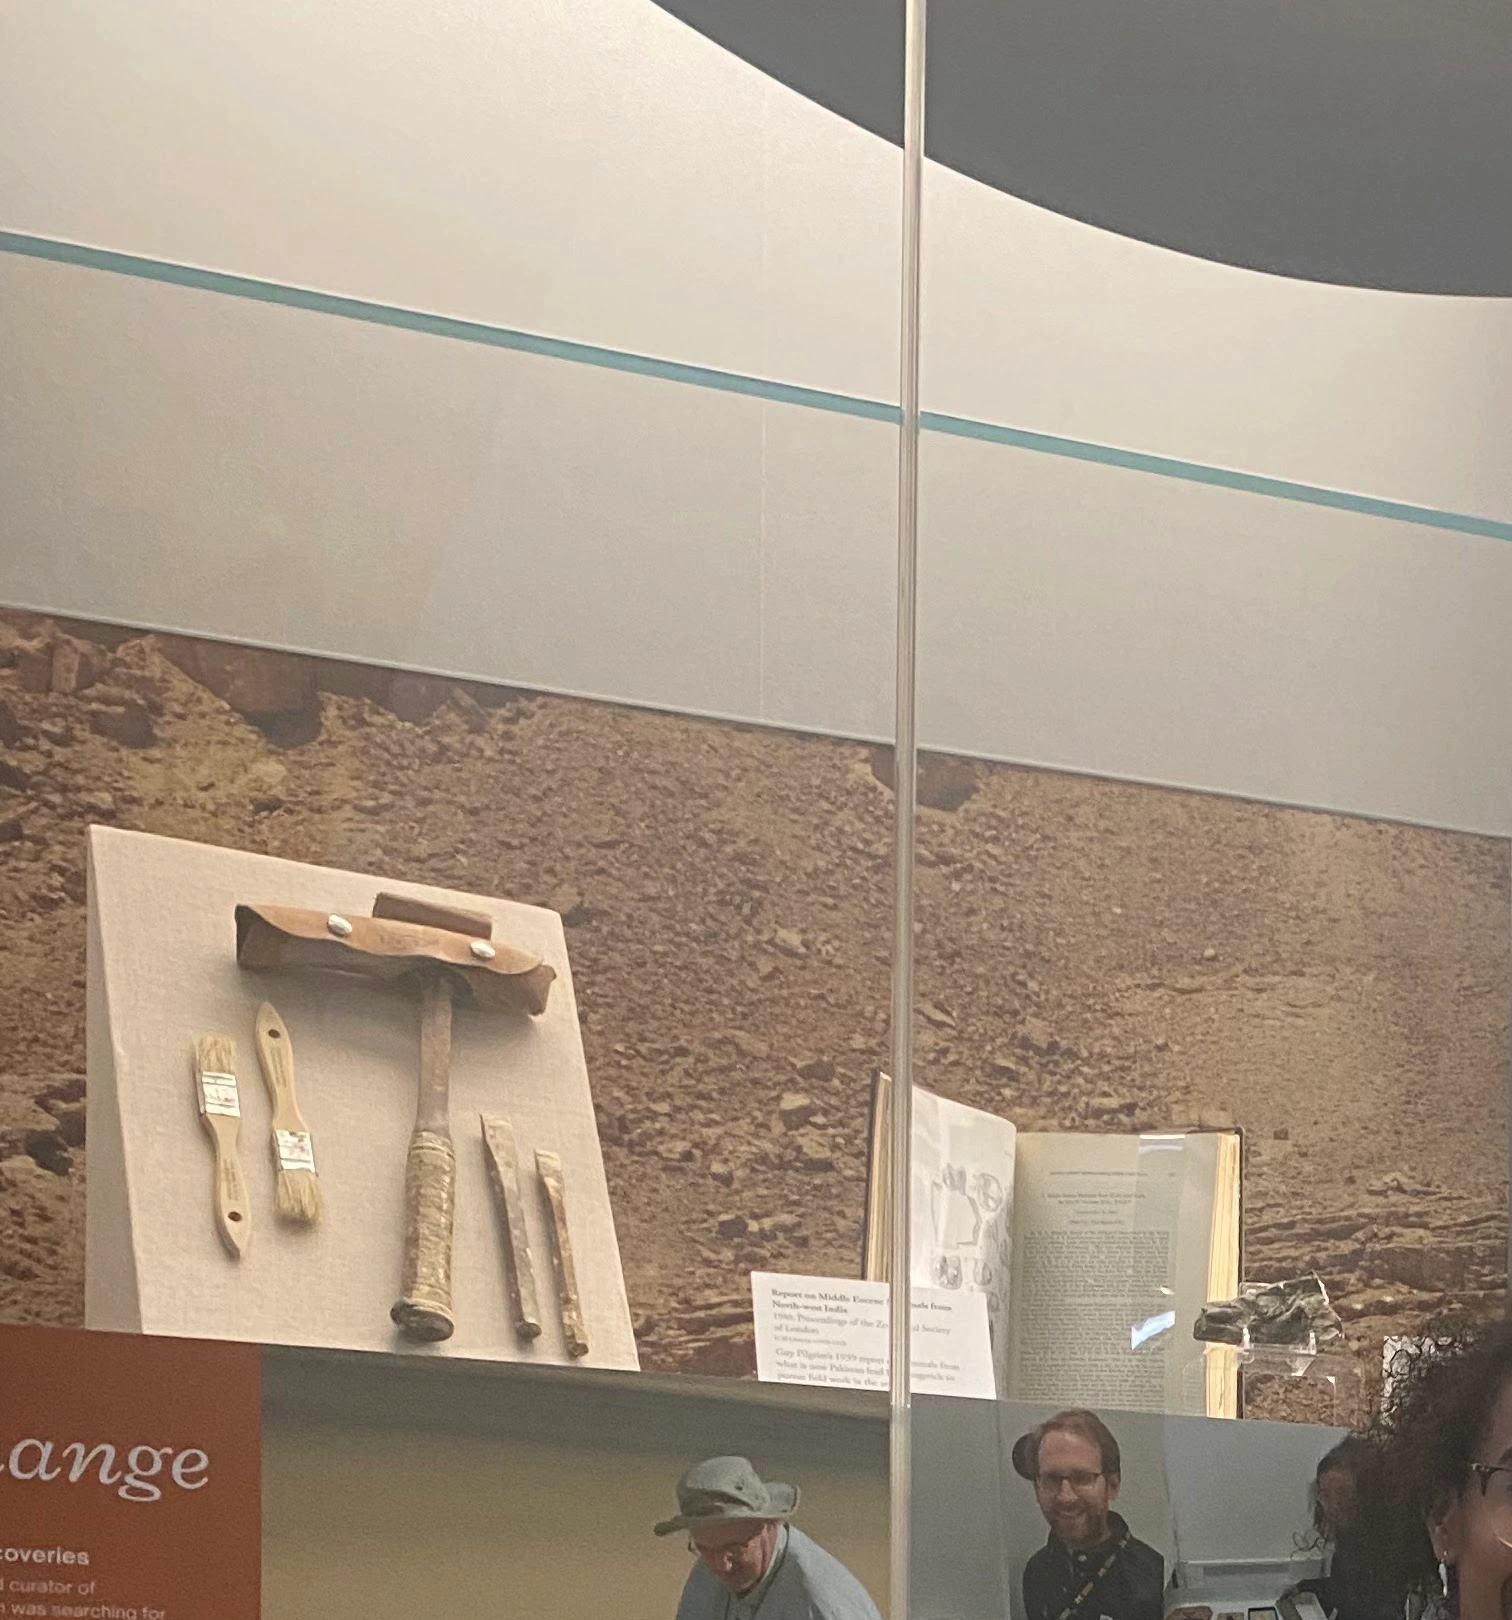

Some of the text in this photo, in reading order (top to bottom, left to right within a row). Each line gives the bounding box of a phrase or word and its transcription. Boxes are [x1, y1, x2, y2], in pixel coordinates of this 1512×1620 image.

[0, 1436, 211, 1502] ange
[9, 1579, 96, 1596] curator of
[12, 1604, 46, 1615] was
[143, 1606, 165, 1620] for
